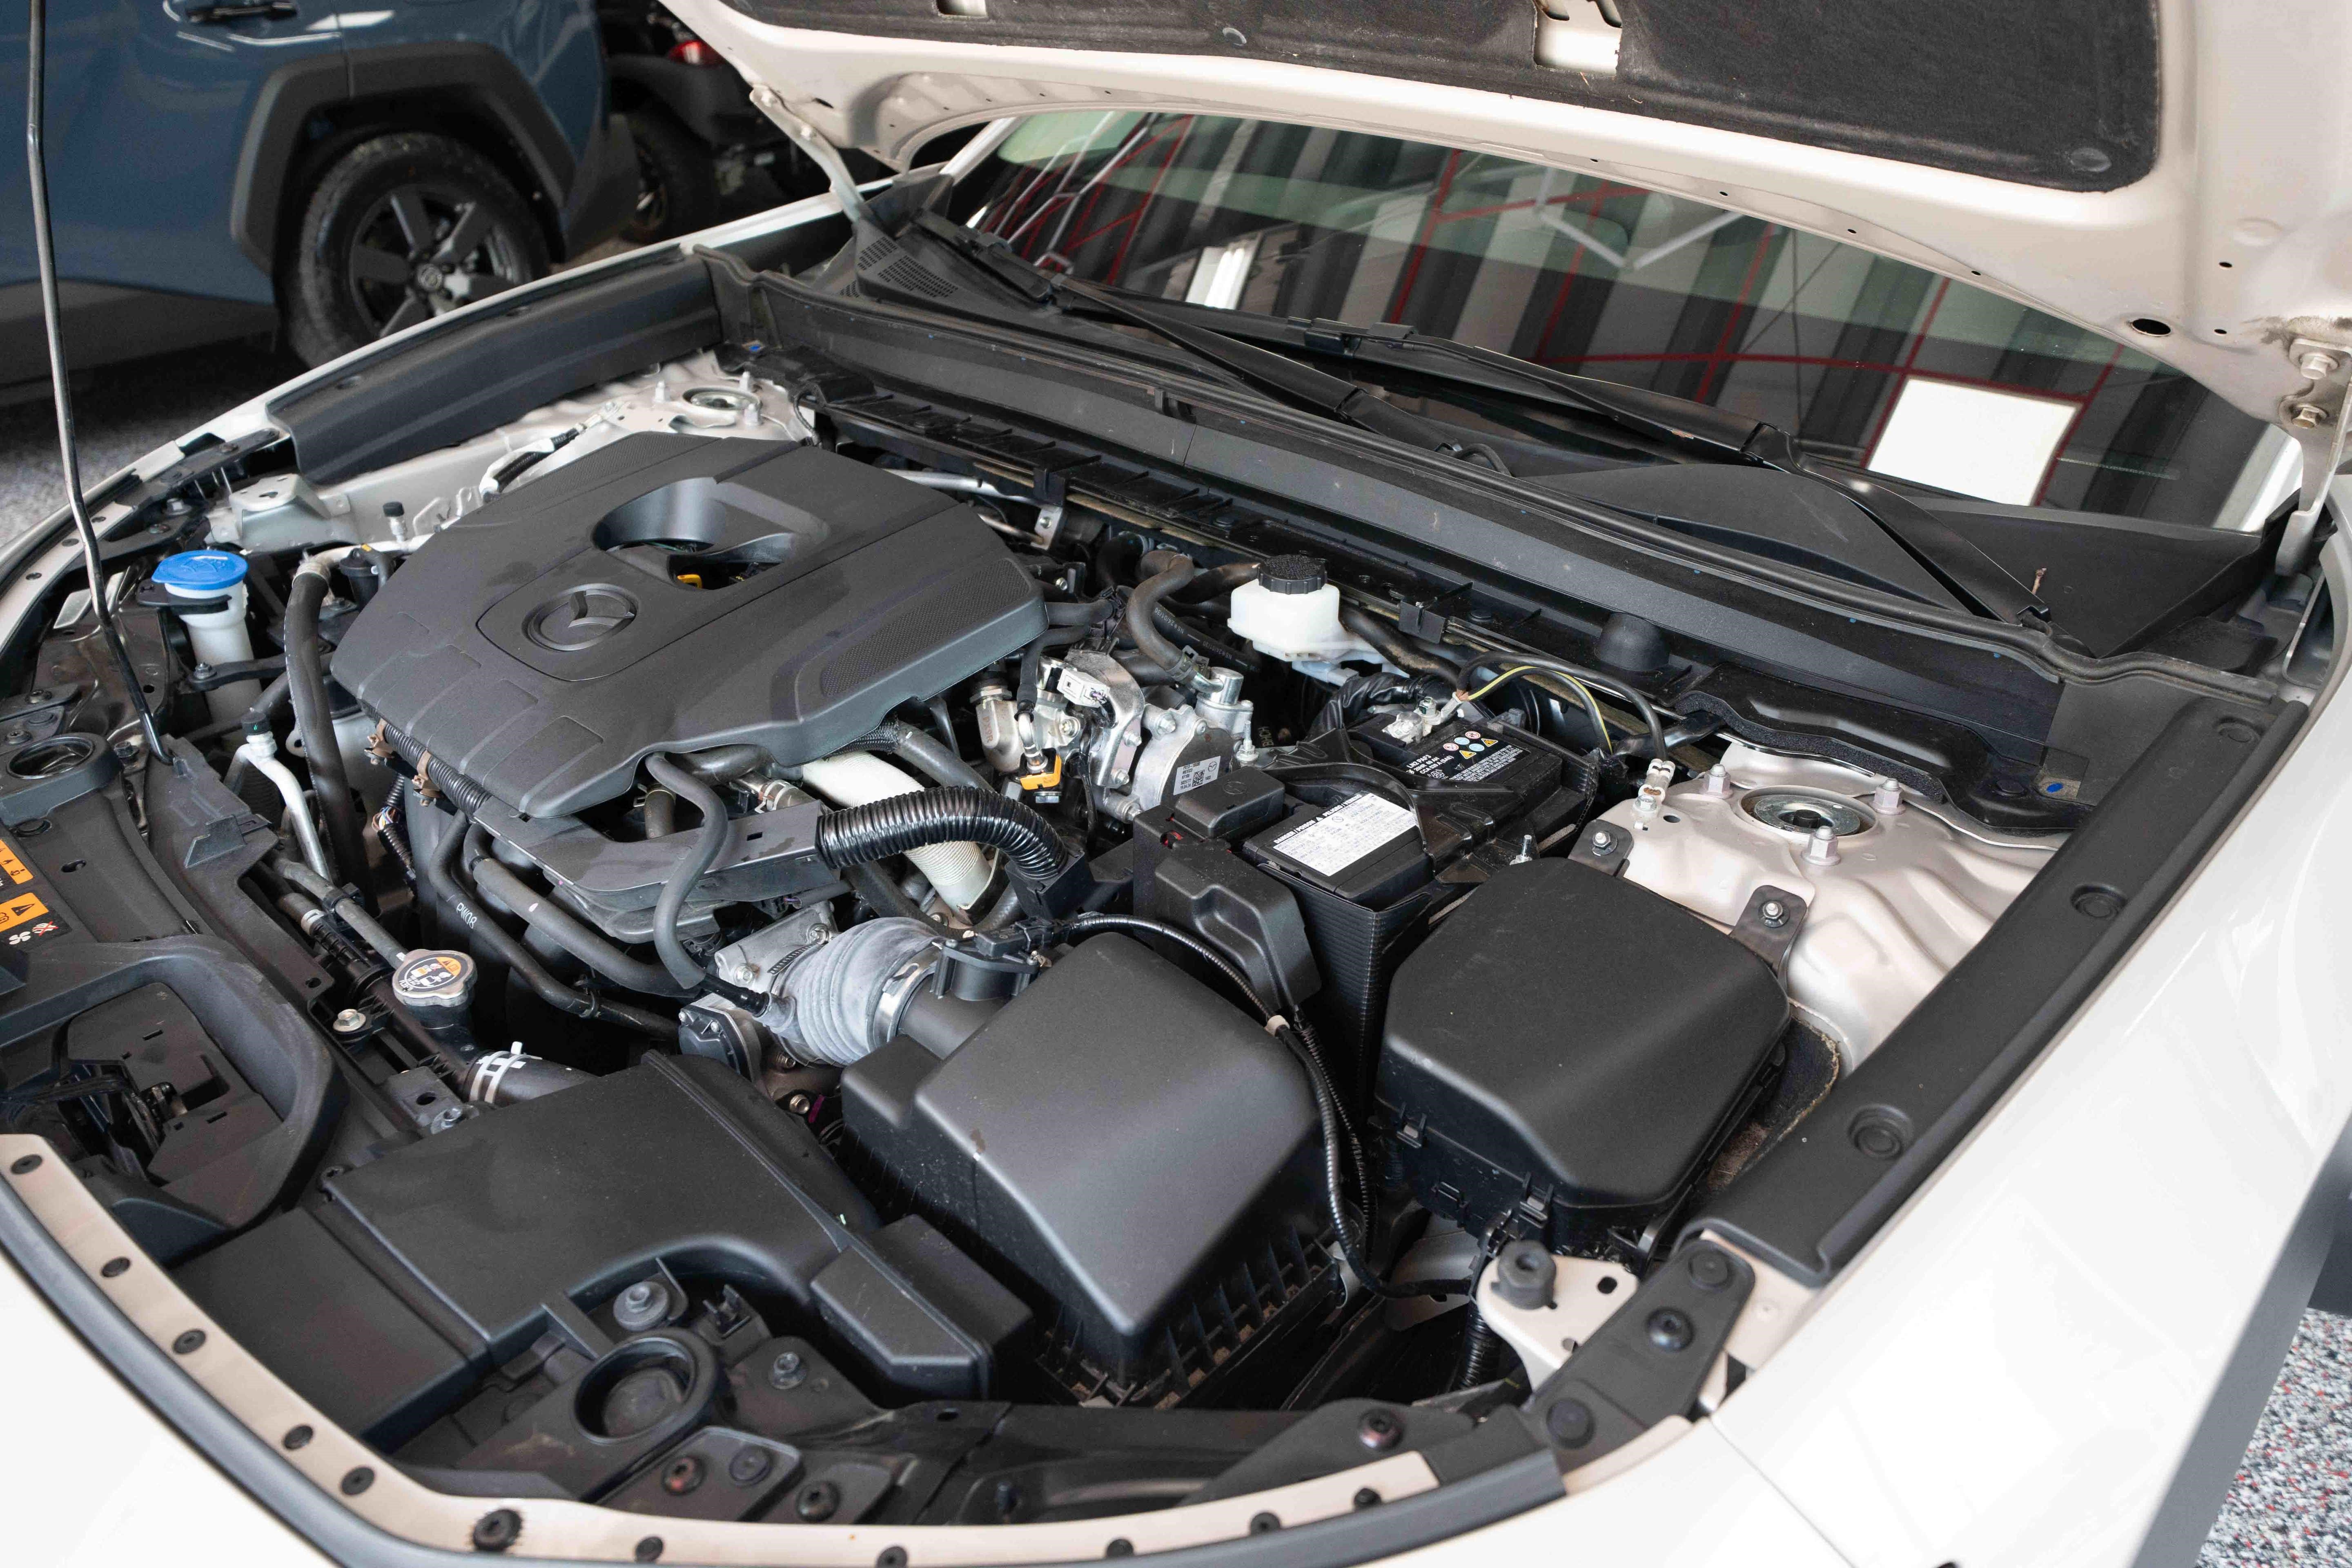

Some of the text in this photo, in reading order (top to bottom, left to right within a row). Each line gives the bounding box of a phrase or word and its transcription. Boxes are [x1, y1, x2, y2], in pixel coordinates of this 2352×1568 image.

[1440, 755, 1454, 764] (SAE)
[1322, 804, 1341, 817] PELIGRO
[1273, 831, 1295, 844] DANGER
[1296, 820, 1316, 832] POISON
